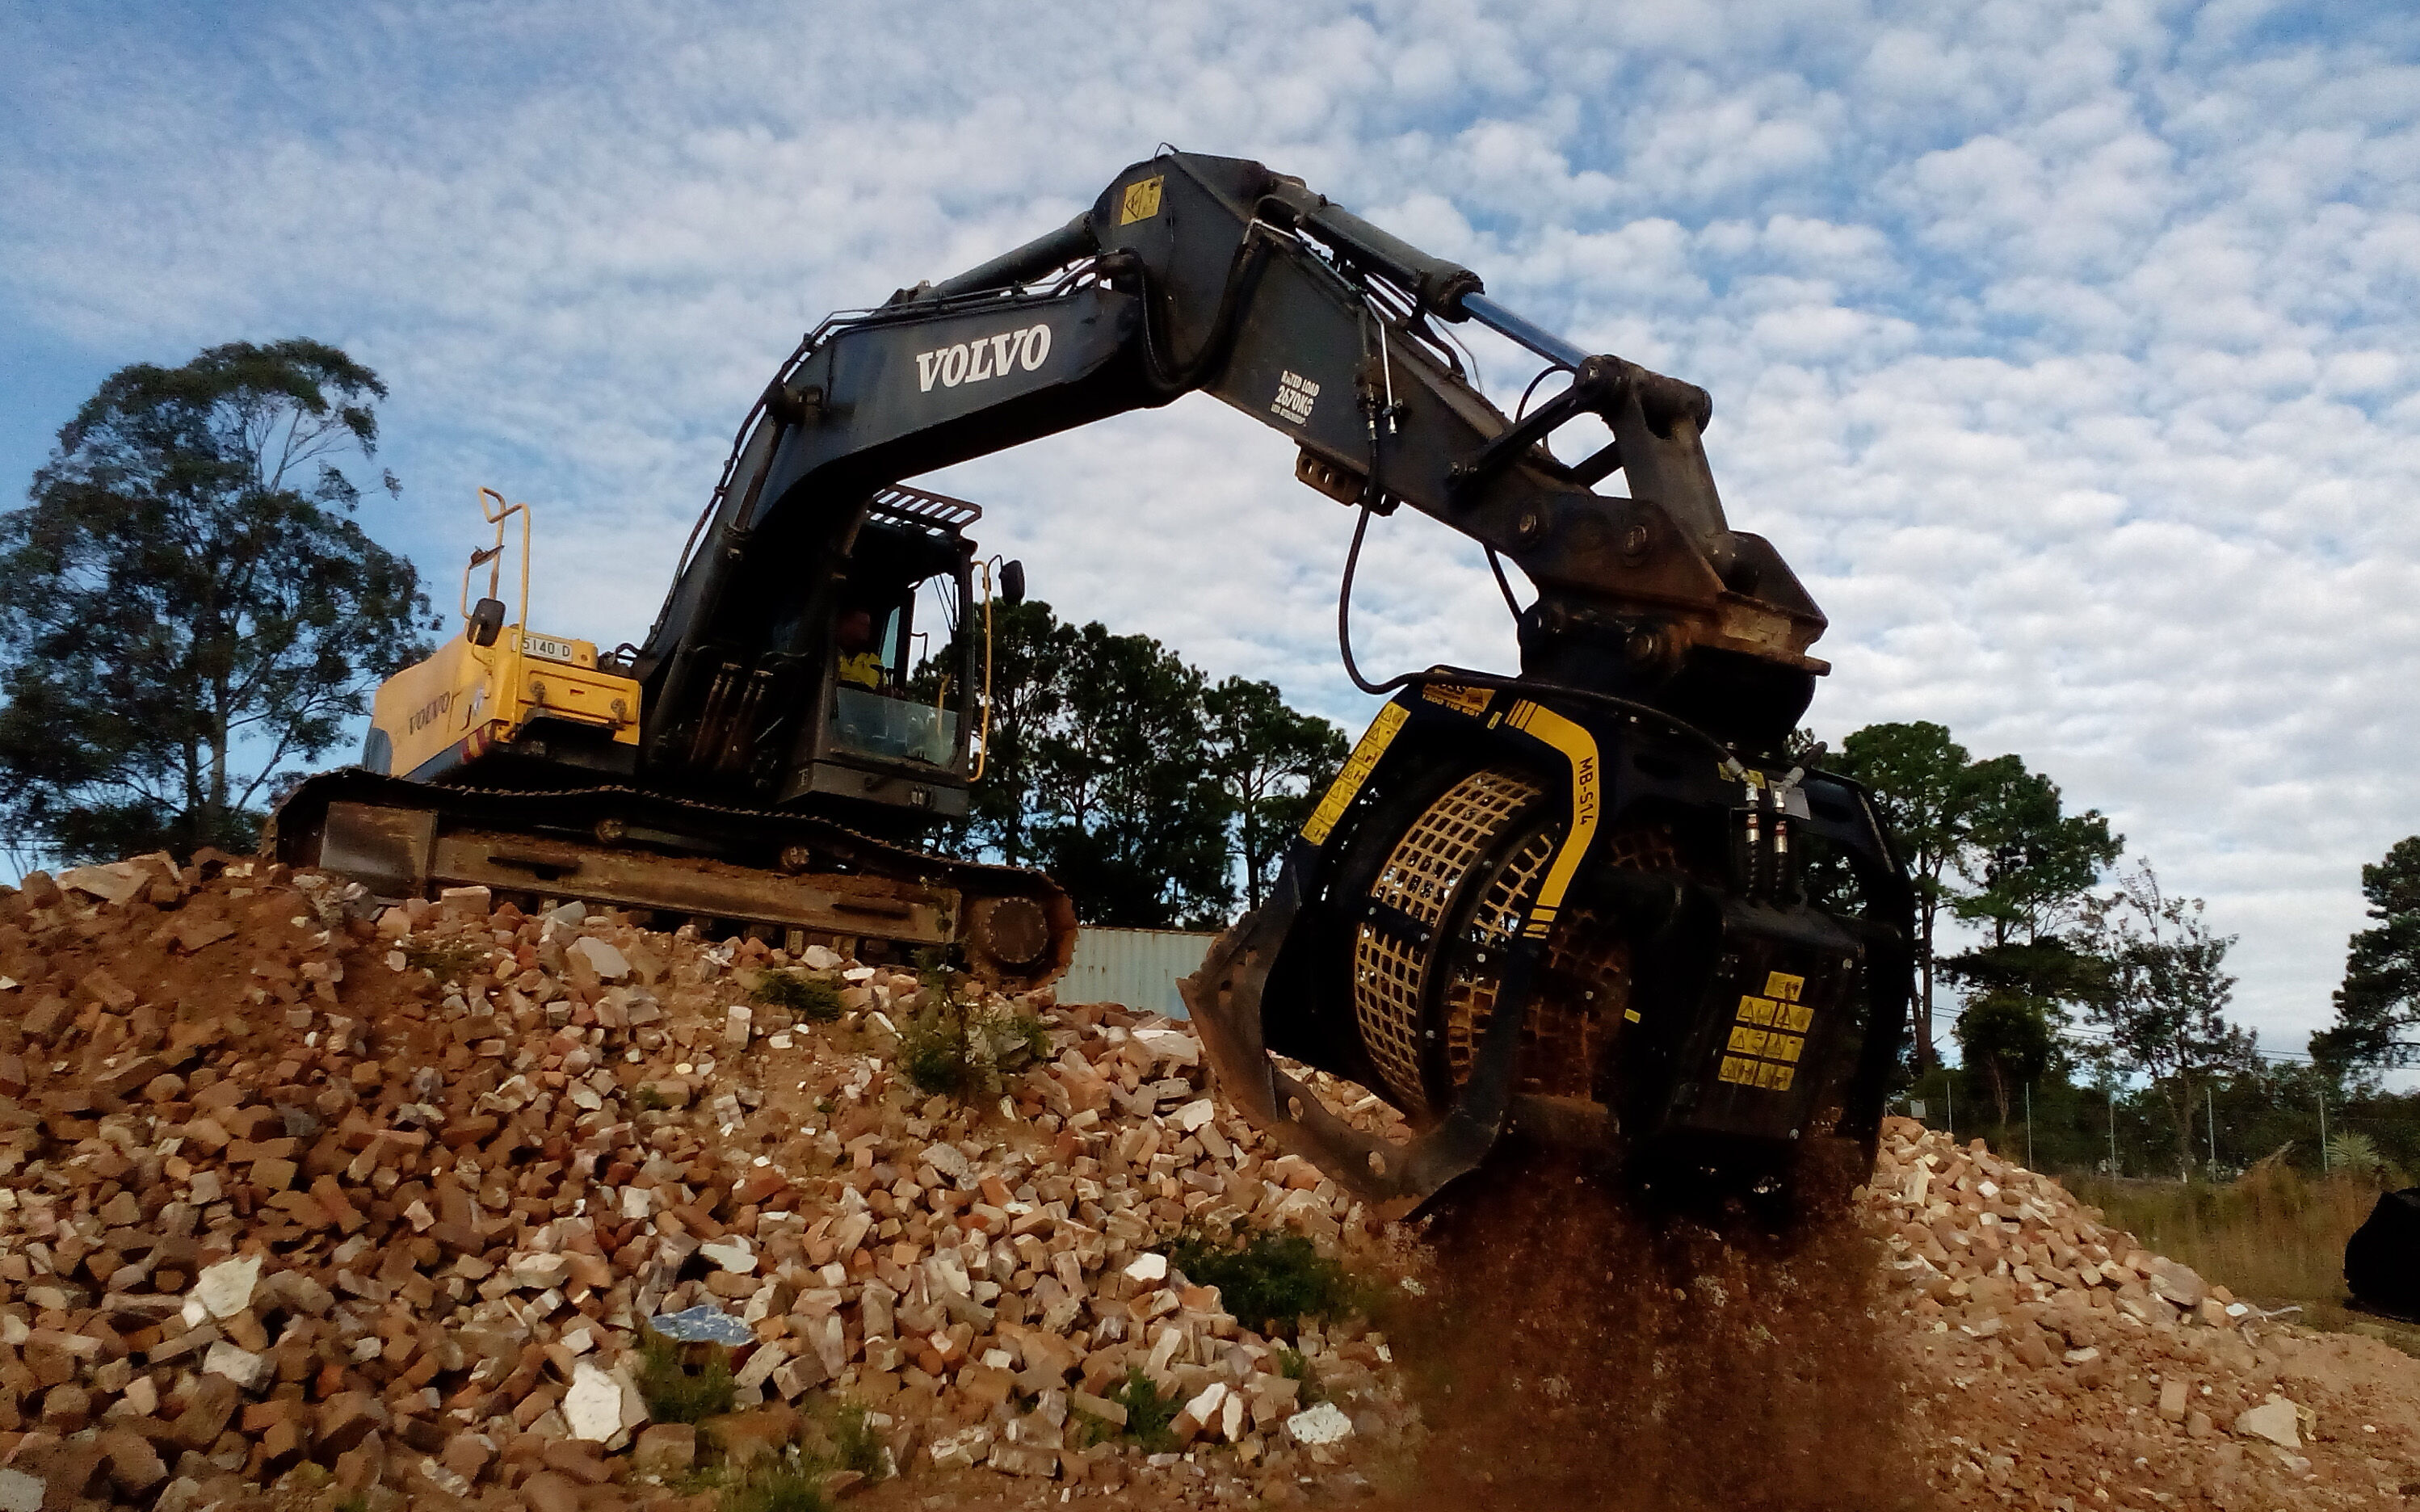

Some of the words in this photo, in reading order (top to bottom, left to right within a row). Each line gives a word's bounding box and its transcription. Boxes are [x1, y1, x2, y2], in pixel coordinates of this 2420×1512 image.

[916, 324, 1052, 393] VOLVO
[1280, 370, 1303, 389] RATED
[1301, 379, 1321, 397] LOAD
[1274, 384, 1314, 417] 2670KG
[1579, 756, 1594, 825] MB-S14
